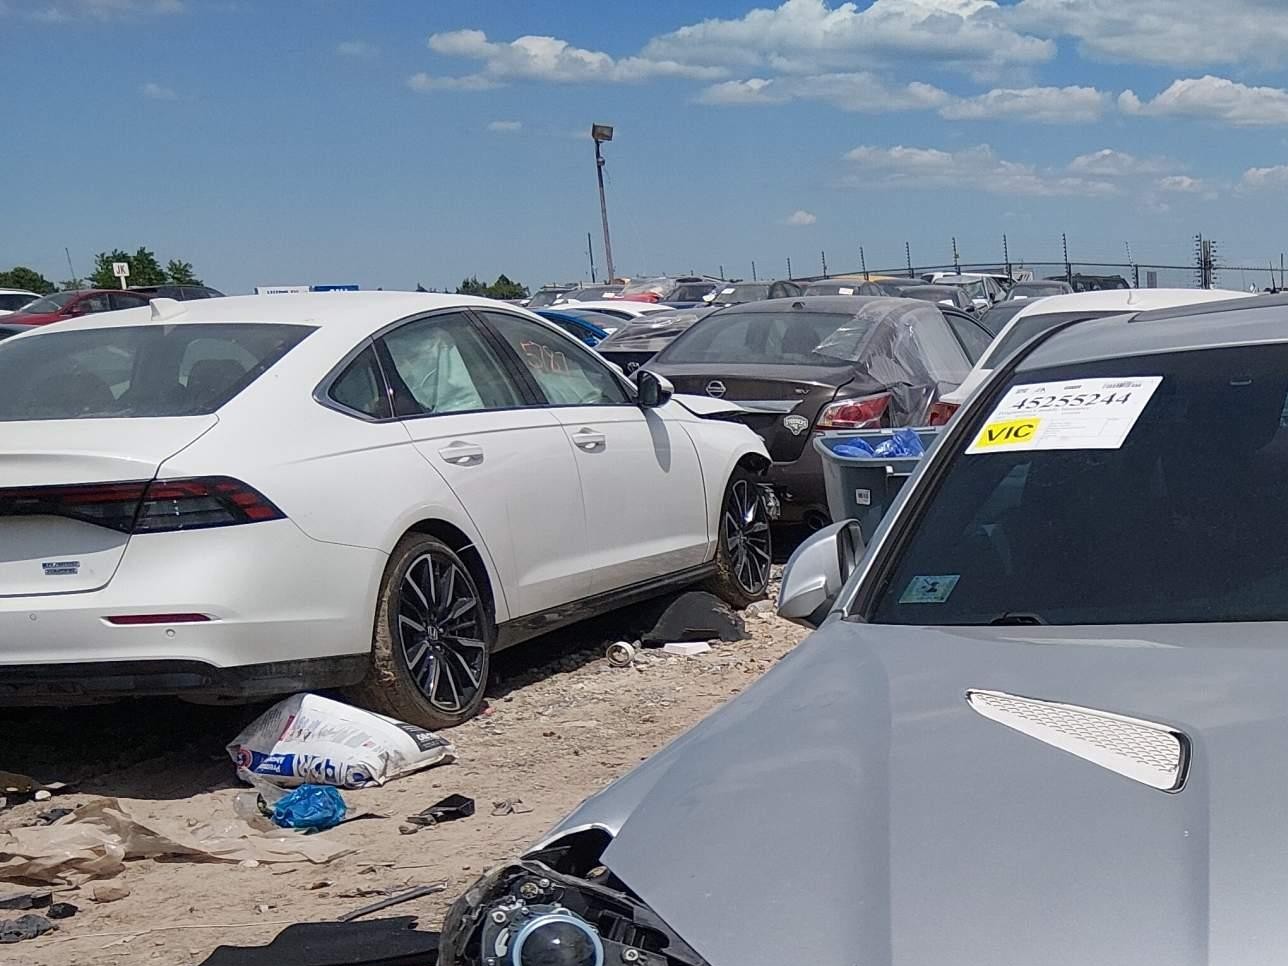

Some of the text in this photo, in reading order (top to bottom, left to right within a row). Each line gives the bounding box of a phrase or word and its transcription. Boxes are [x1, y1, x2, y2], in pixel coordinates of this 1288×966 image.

[116, 264, 126, 274] JK
[1013, 392, 1133, 410] 45255244
[987, 424, 1034, 442] VIC
